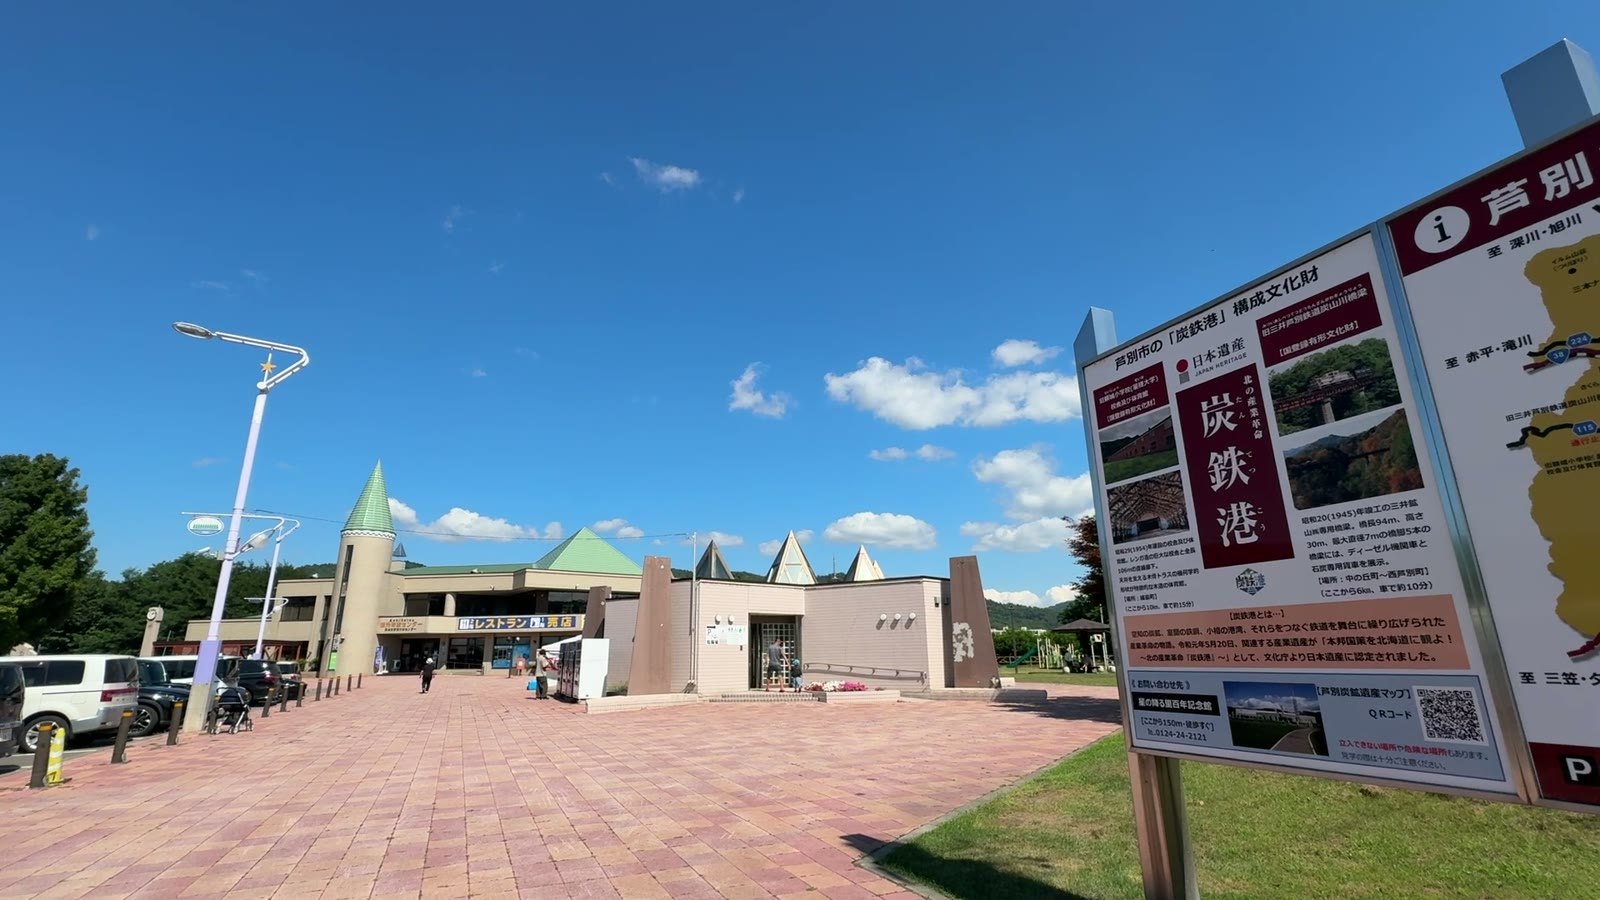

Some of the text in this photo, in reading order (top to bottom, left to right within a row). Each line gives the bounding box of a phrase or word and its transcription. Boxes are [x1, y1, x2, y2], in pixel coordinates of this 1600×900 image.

[1480, 151, 1594, 227] 芦別
[1486, 212, 1583, 260] 至 深川・旭川
[1192, 337, 1246, 369] 日本遺産
[1195, 352, 1248, 377] JAPAN HERITAGE
[1444, 334, 1533, 370] 至 赤平・滝川
[1242, 374, 1264, 440] 北の産業革命
[1577, 423, 1594, 433] 115
[1200, 392, 1259, 548] 炭鉄港
[475, 618, 528, 629] レストラン
[1518, 671, 1537, 685] 至
[1565, 757, 1592, 782] P
